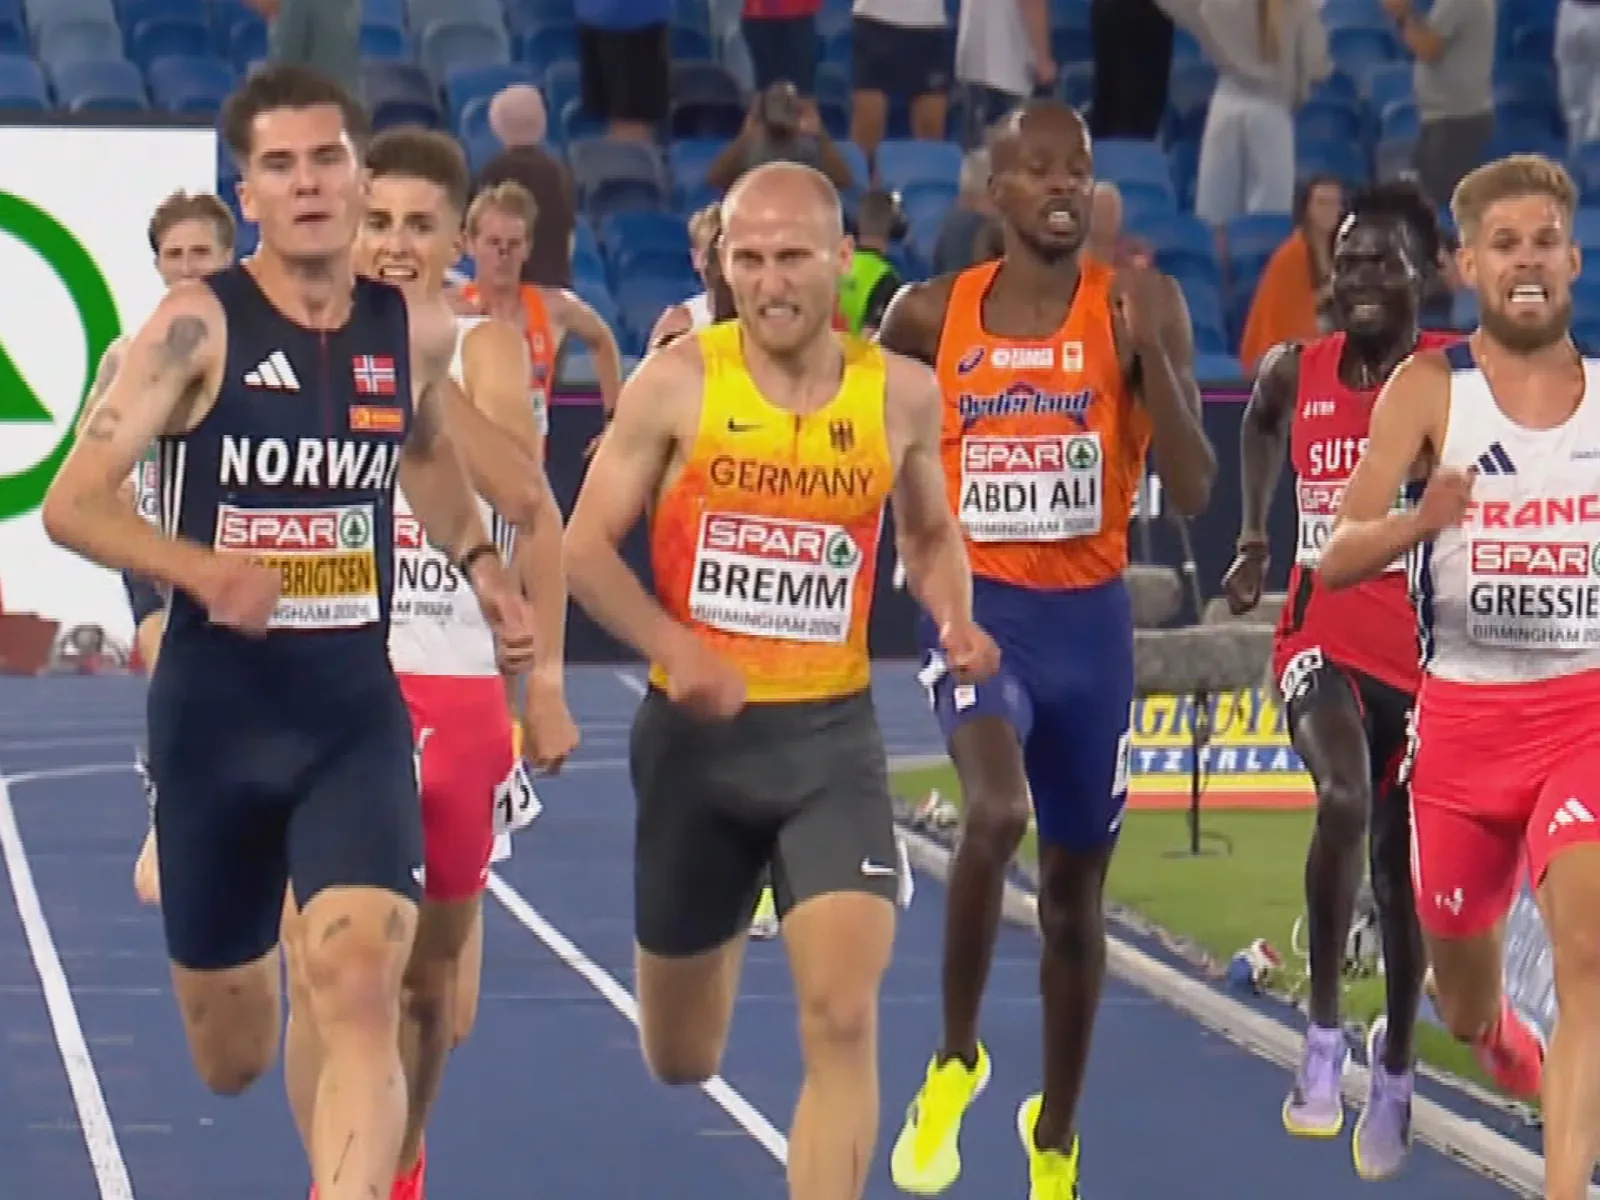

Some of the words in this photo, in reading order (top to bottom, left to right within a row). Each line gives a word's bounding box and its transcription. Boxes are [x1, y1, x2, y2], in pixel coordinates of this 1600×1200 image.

[219, 434, 400, 489] NORWA
[967, 443, 1061, 470] SPAR
[709, 455, 874, 499] GERMANY
[963, 482, 1037, 512] ABDI
[1050, 478, 1095, 510] ALI
[221, 516, 336, 548] SPAR
[706, 519, 823, 561] SPAR
[1475, 543, 1588, 574] SPAR
[697, 559, 847, 611] BREMM
[1471, 583, 1600, 619] GRESSIE
[1133, 689, 1286, 736] GRUY
